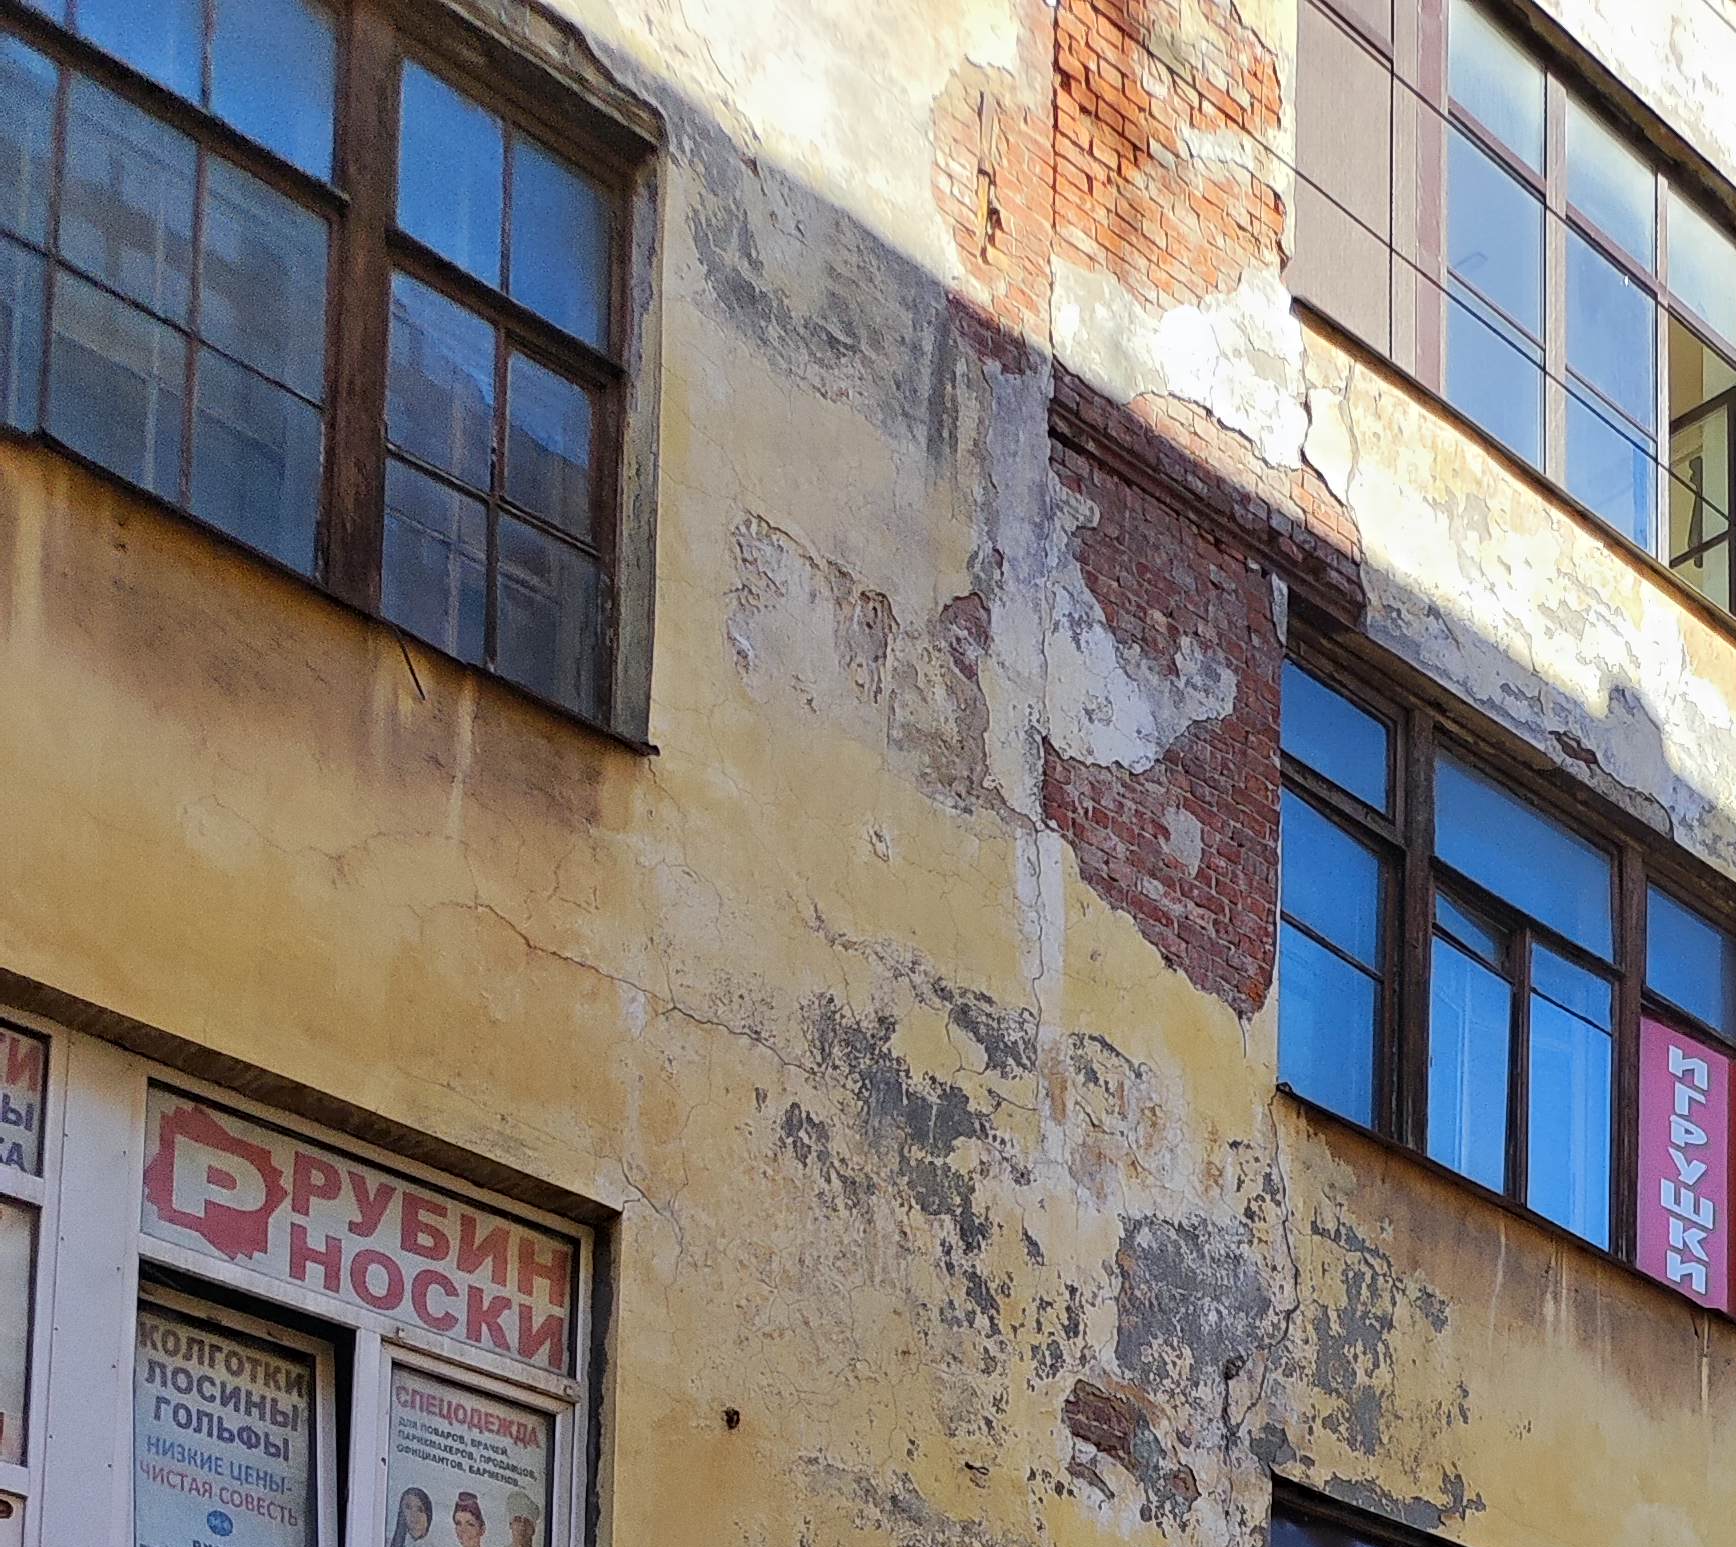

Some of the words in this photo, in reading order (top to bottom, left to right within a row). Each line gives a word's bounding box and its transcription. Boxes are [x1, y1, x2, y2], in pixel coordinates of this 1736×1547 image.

[1660, 1044, 1714, 1295] ИГРУШКИ
[292, 1151, 570, 1308] РУБИН
[289, 1222, 563, 1370] НОСКИ
[139, 1322, 305, 1398] КОЛГОТКИ
[145, 1359, 299, 1432] ЛОСИНЫ
[153, 1396, 289, 1462] ГОЛЬФЫ
[396, 1385, 540, 1449] СПЕЦОДЕЖДА
[147, 1435, 224, 1475] НИЗКИЕ
[397, 1444, 466, 1473] ОФИЦИАНТОВ,
[398, 1429, 477, 1463] ПАРИКМАХЕРОВ,
[479, 1454, 538, 1482] ПРОДАВЦОВ,
[421, 1423, 468, 1447] ПОВАРОВ,
[139, 1459, 212, 1499] ЧИСТАЯ
[219, 1486, 298, 1527] СОВЕСТЬ
